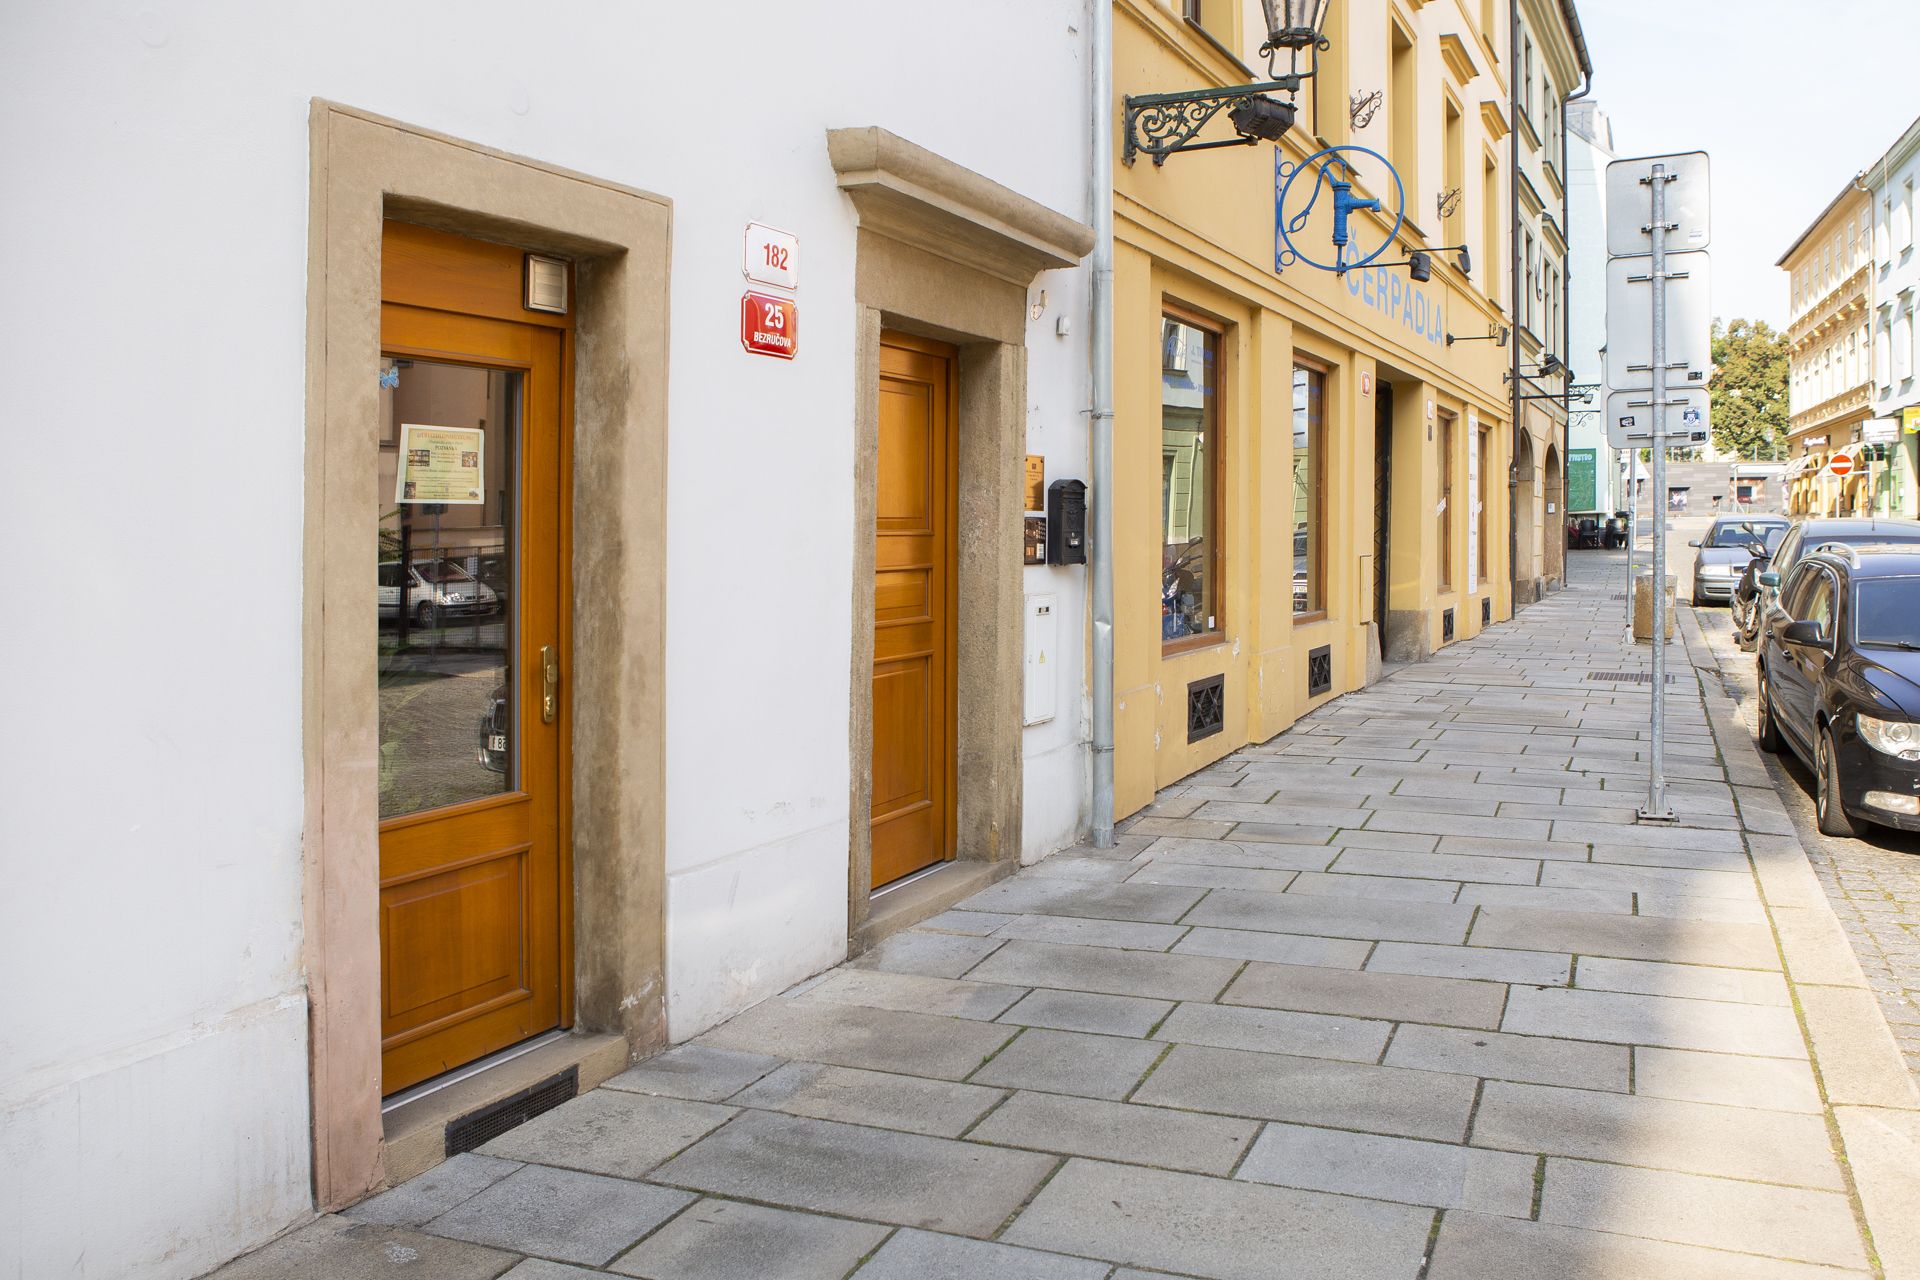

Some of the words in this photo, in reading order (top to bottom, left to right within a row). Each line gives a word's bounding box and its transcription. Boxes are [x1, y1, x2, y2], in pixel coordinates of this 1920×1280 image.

[763, 242, 789, 271] 182
[1345, 226, 1443, 348] ČERPADLA
[764, 302, 784, 329] 25
[754, 331, 791, 347] BEZRUČOVA
